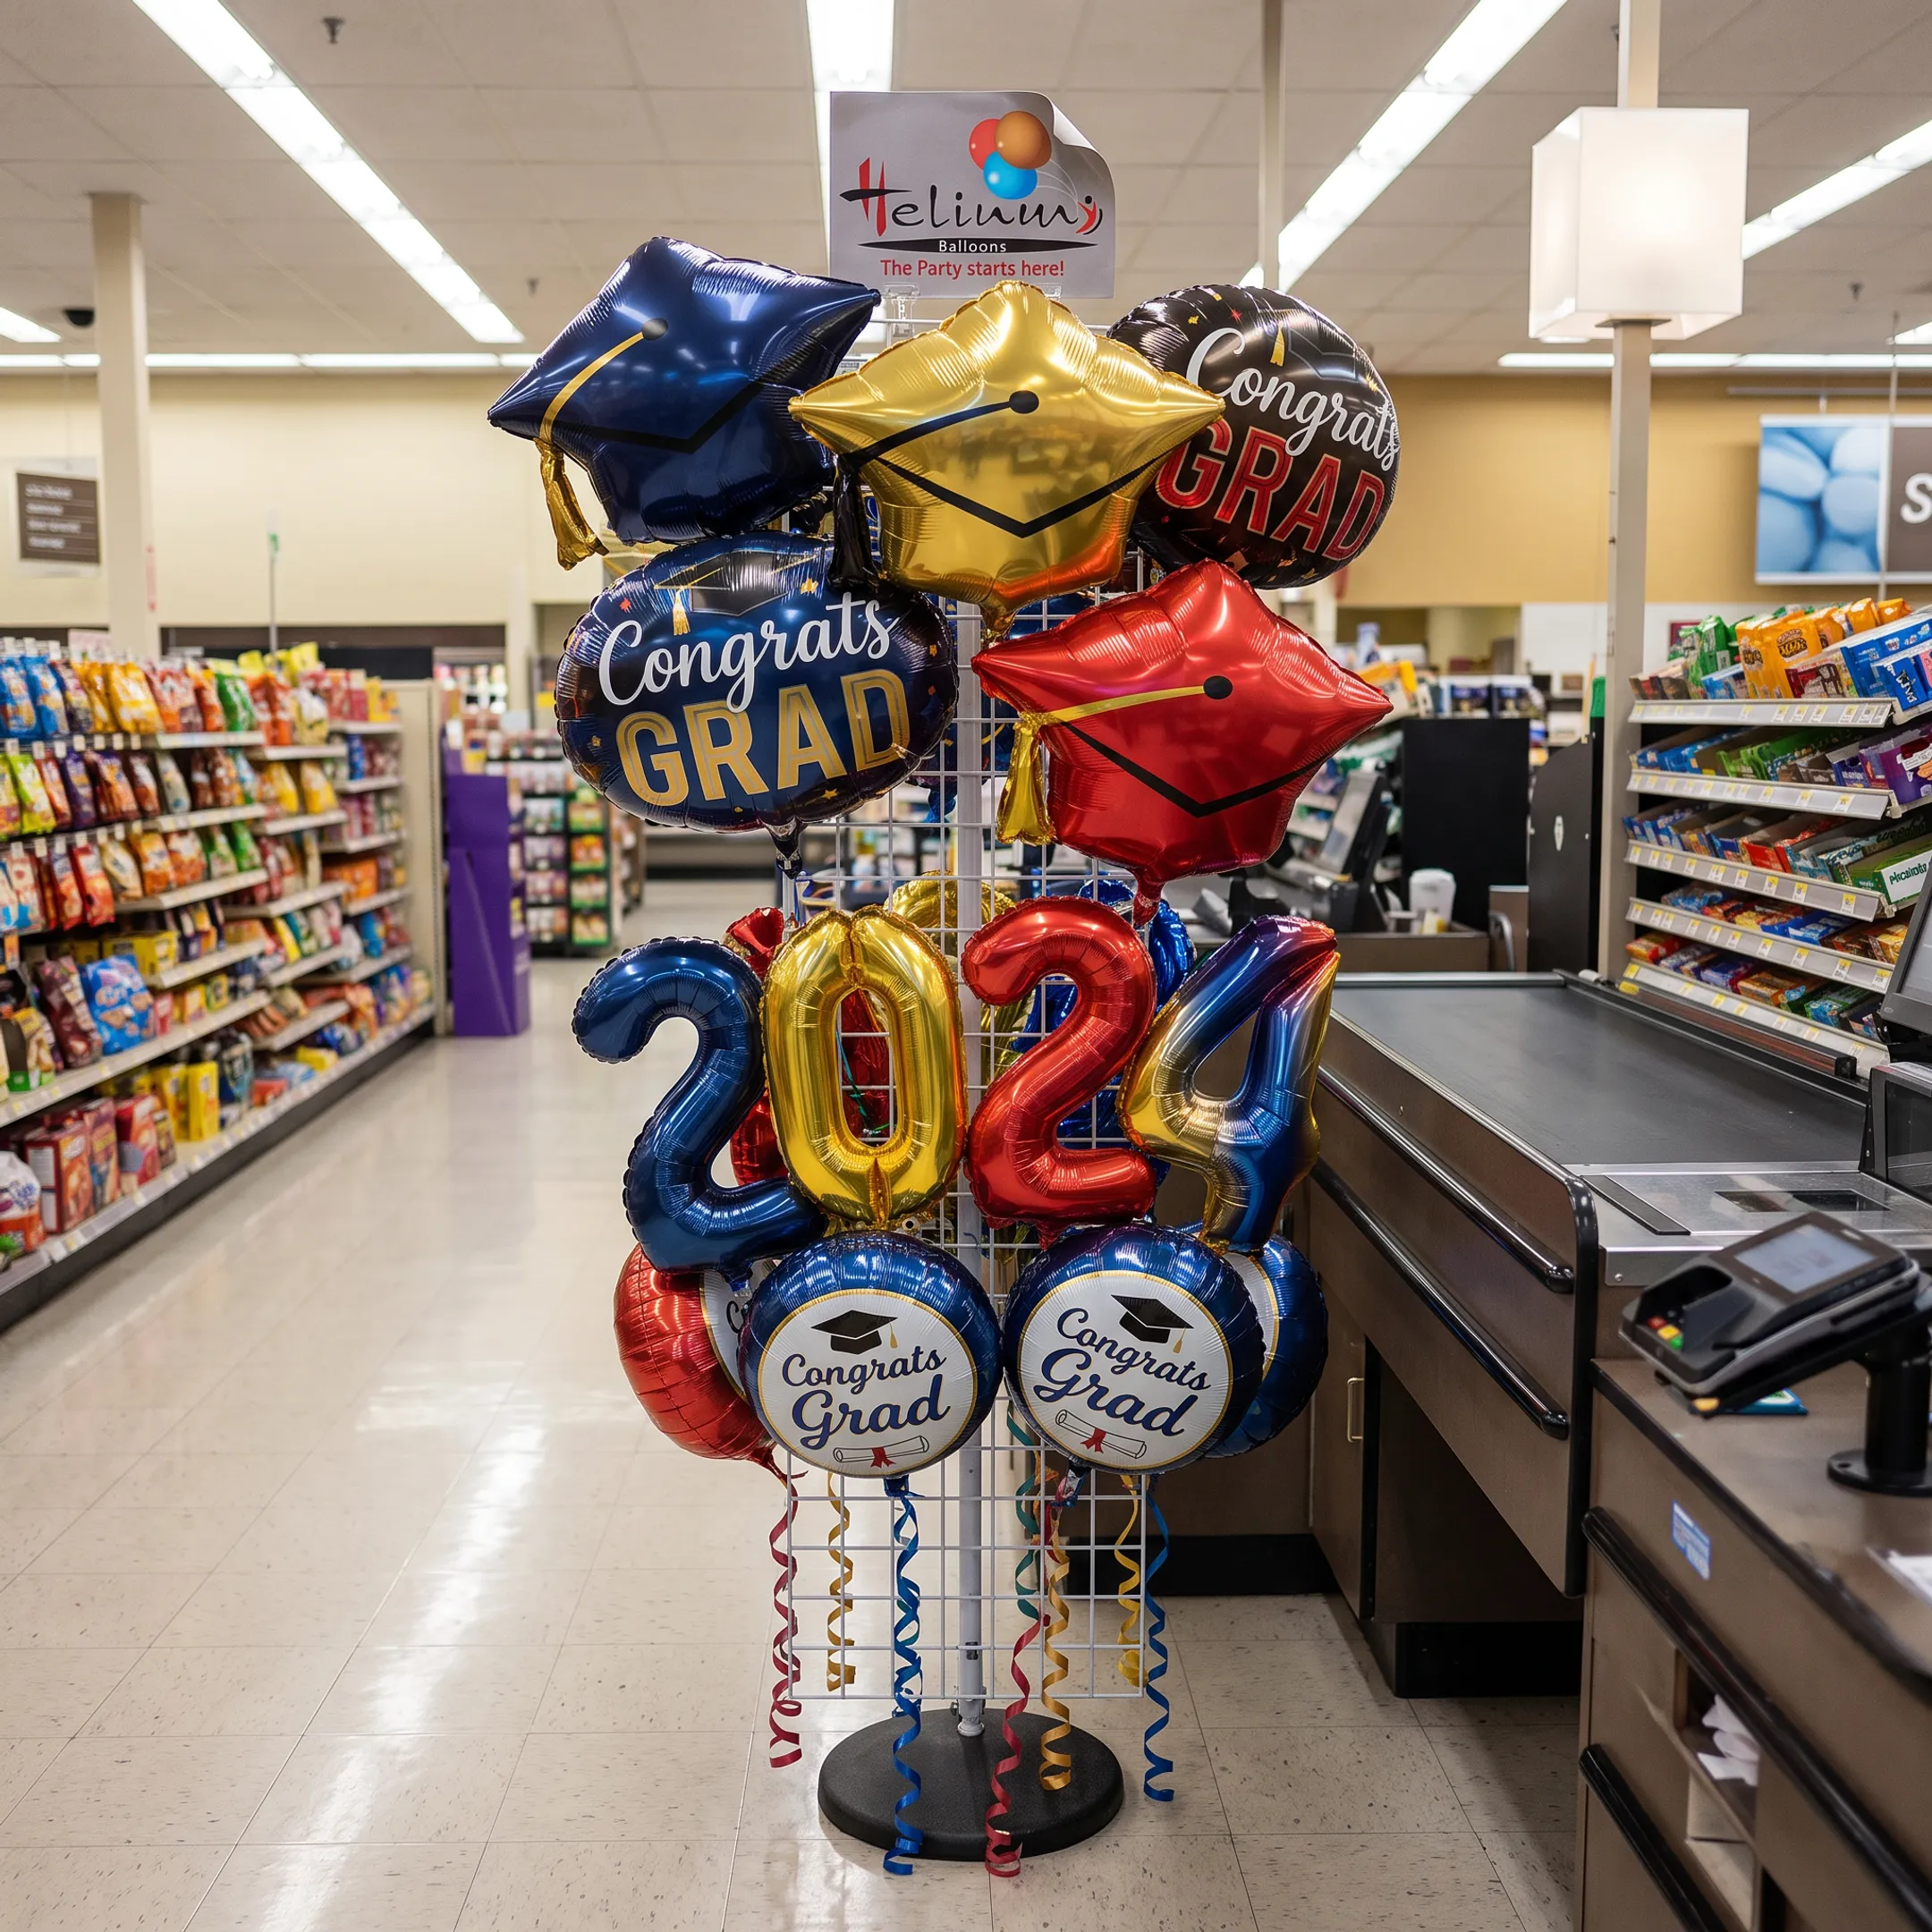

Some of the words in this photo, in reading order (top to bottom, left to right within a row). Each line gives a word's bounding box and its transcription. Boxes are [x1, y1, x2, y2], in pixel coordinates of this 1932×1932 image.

[880, 259, 912, 275] The
[918, 259, 962, 280] Party
[967, 260, 1016, 277] starts
[1021, 259, 1064, 277] here!
[938, 240, 1007, 253] Balloons
[1186, 327, 1401, 471] Congrats
[1155, 419, 1385, 562] GRAD
[598, 591, 900, 714] Congrats
[615, 669, 911, 807] GRAD
[782, 1345, 947, 1395] Congrats
[1056, 1308, 1211, 1390] Congrats
[792, 1374, 951, 1450] Grad
[1033, 1348, 1199, 1436] Grad
